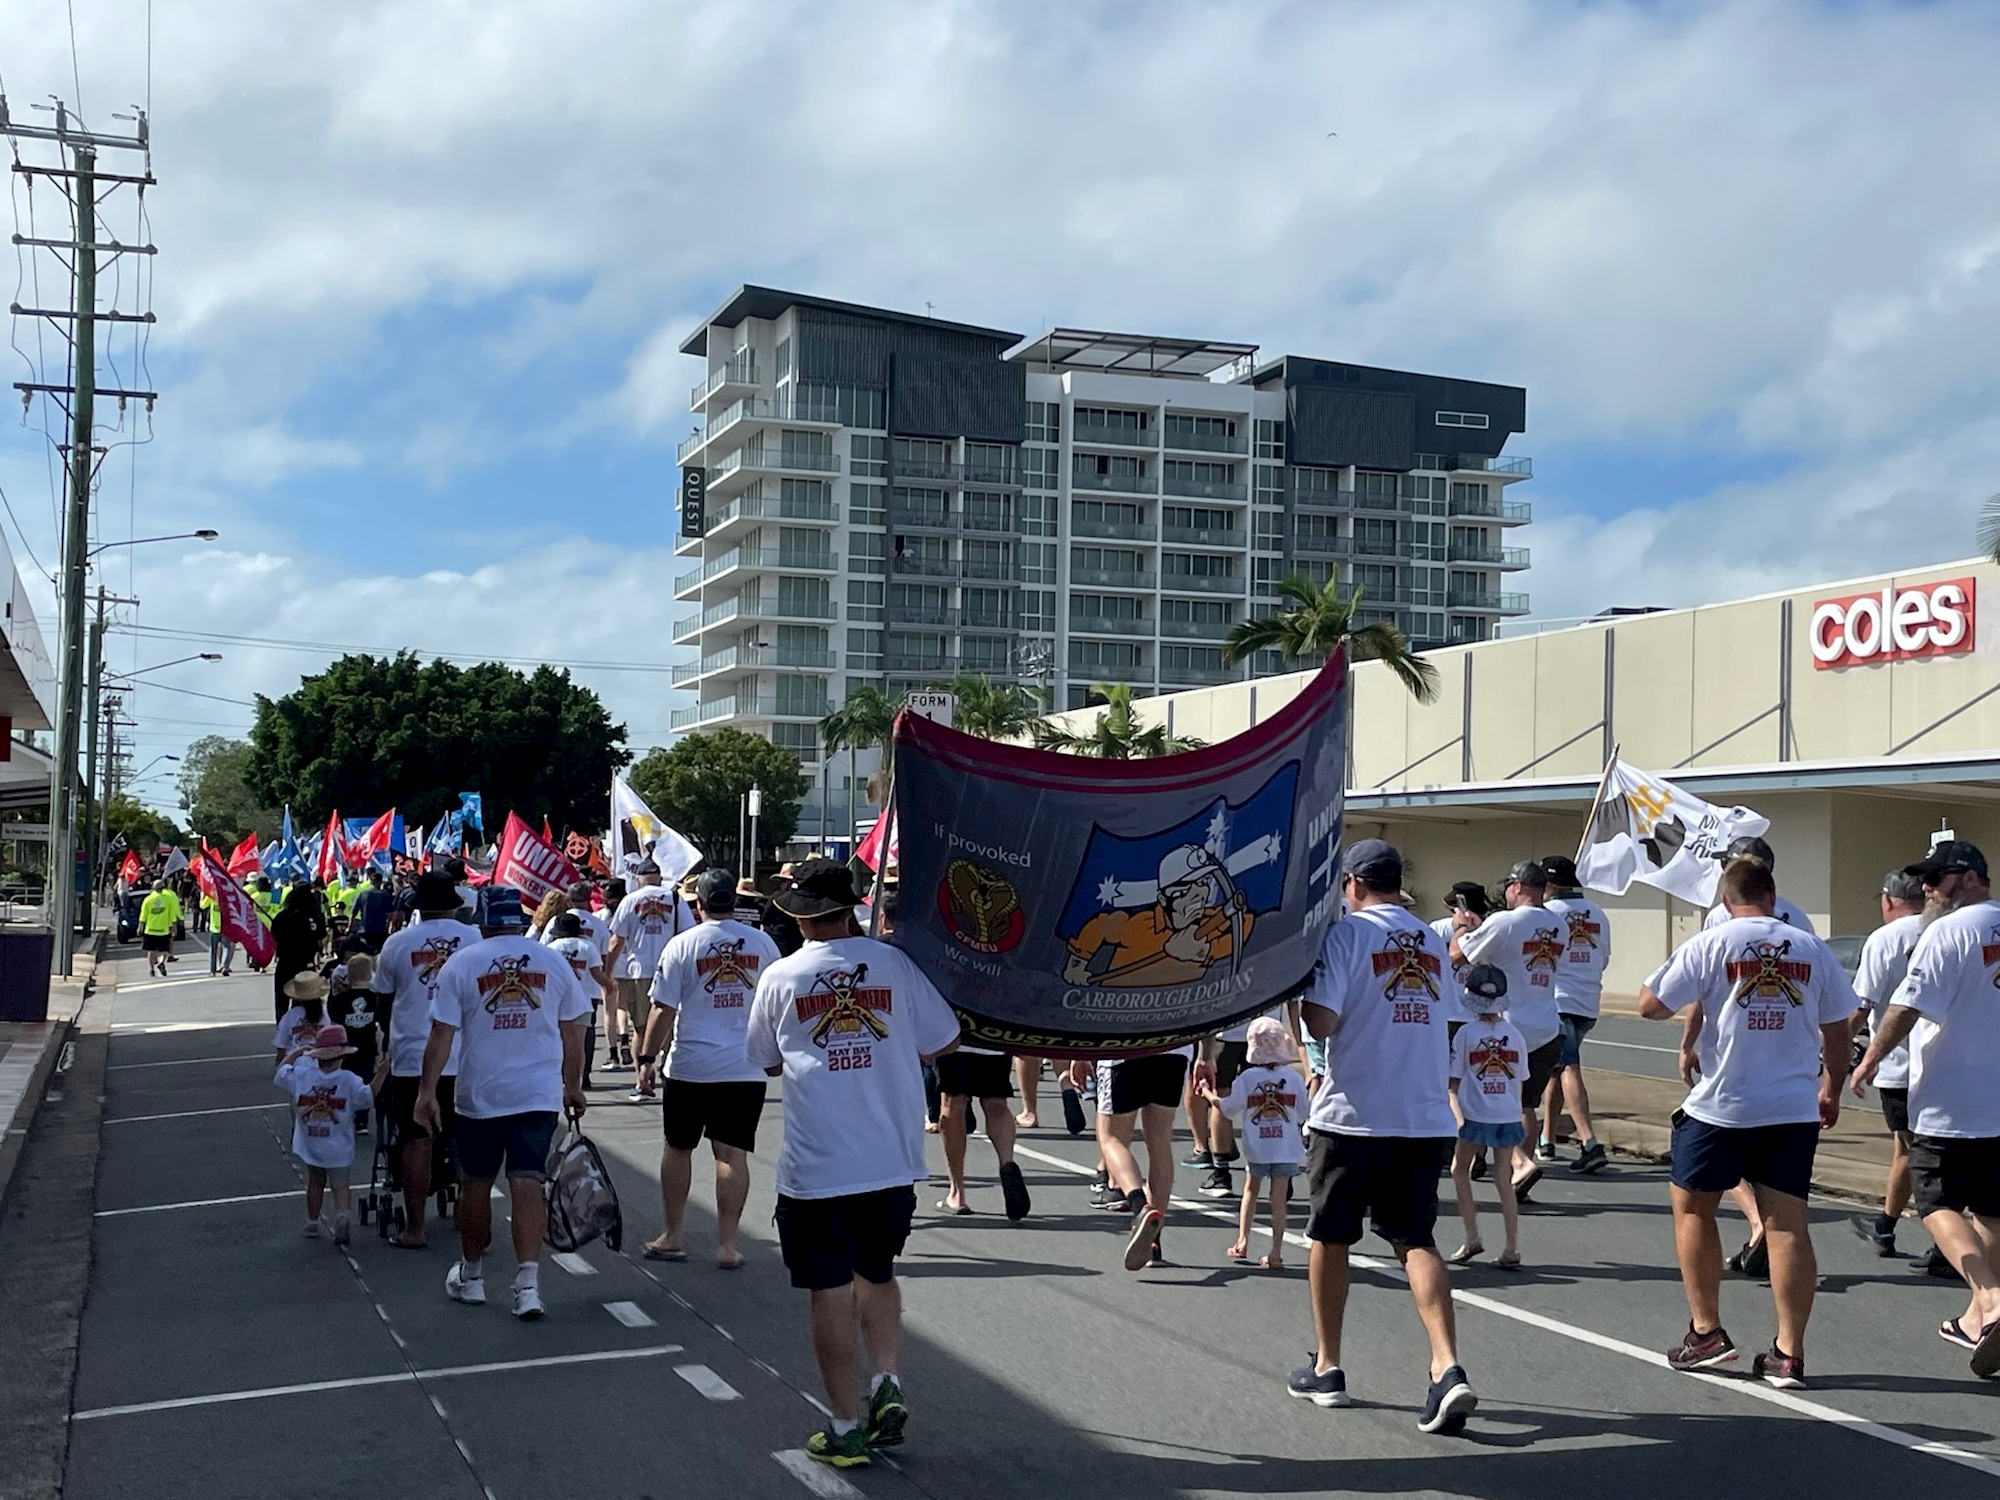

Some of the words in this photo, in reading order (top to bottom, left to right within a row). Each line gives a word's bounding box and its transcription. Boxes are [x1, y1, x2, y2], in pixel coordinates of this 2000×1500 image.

[686, 472, 700, 532] QUEST
[1809, 585, 1967, 661] coles
[911, 696, 946, 707] FORM
[934, 822, 945, 839] If
[948, 832, 1031, 867] provoked
[507, 865, 548, 898] WORKERS
[954, 930, 998, 953] CFMEU
[944, 944, 969, 966] We
[972, 959, 1002, 978] will
[1062, 988, 1191, 1010] CARBOROUGH
[1194, 968, 1254, 999] DOWNS
[713, 1000, 744, 1009] 2022
[493, 1019, 527, 1030] 2022
[1075, 1009, 1187, 1023] UNDERGROUND
[1392, 1010, 1430, 1025] 2022
[1747, 1018, 1785, 1030] 2022
[828, 1048, 850, 1058] MAY
[852, 1046, 872, 1056] DAY
[829, 1054, 872, 1071] 2022
